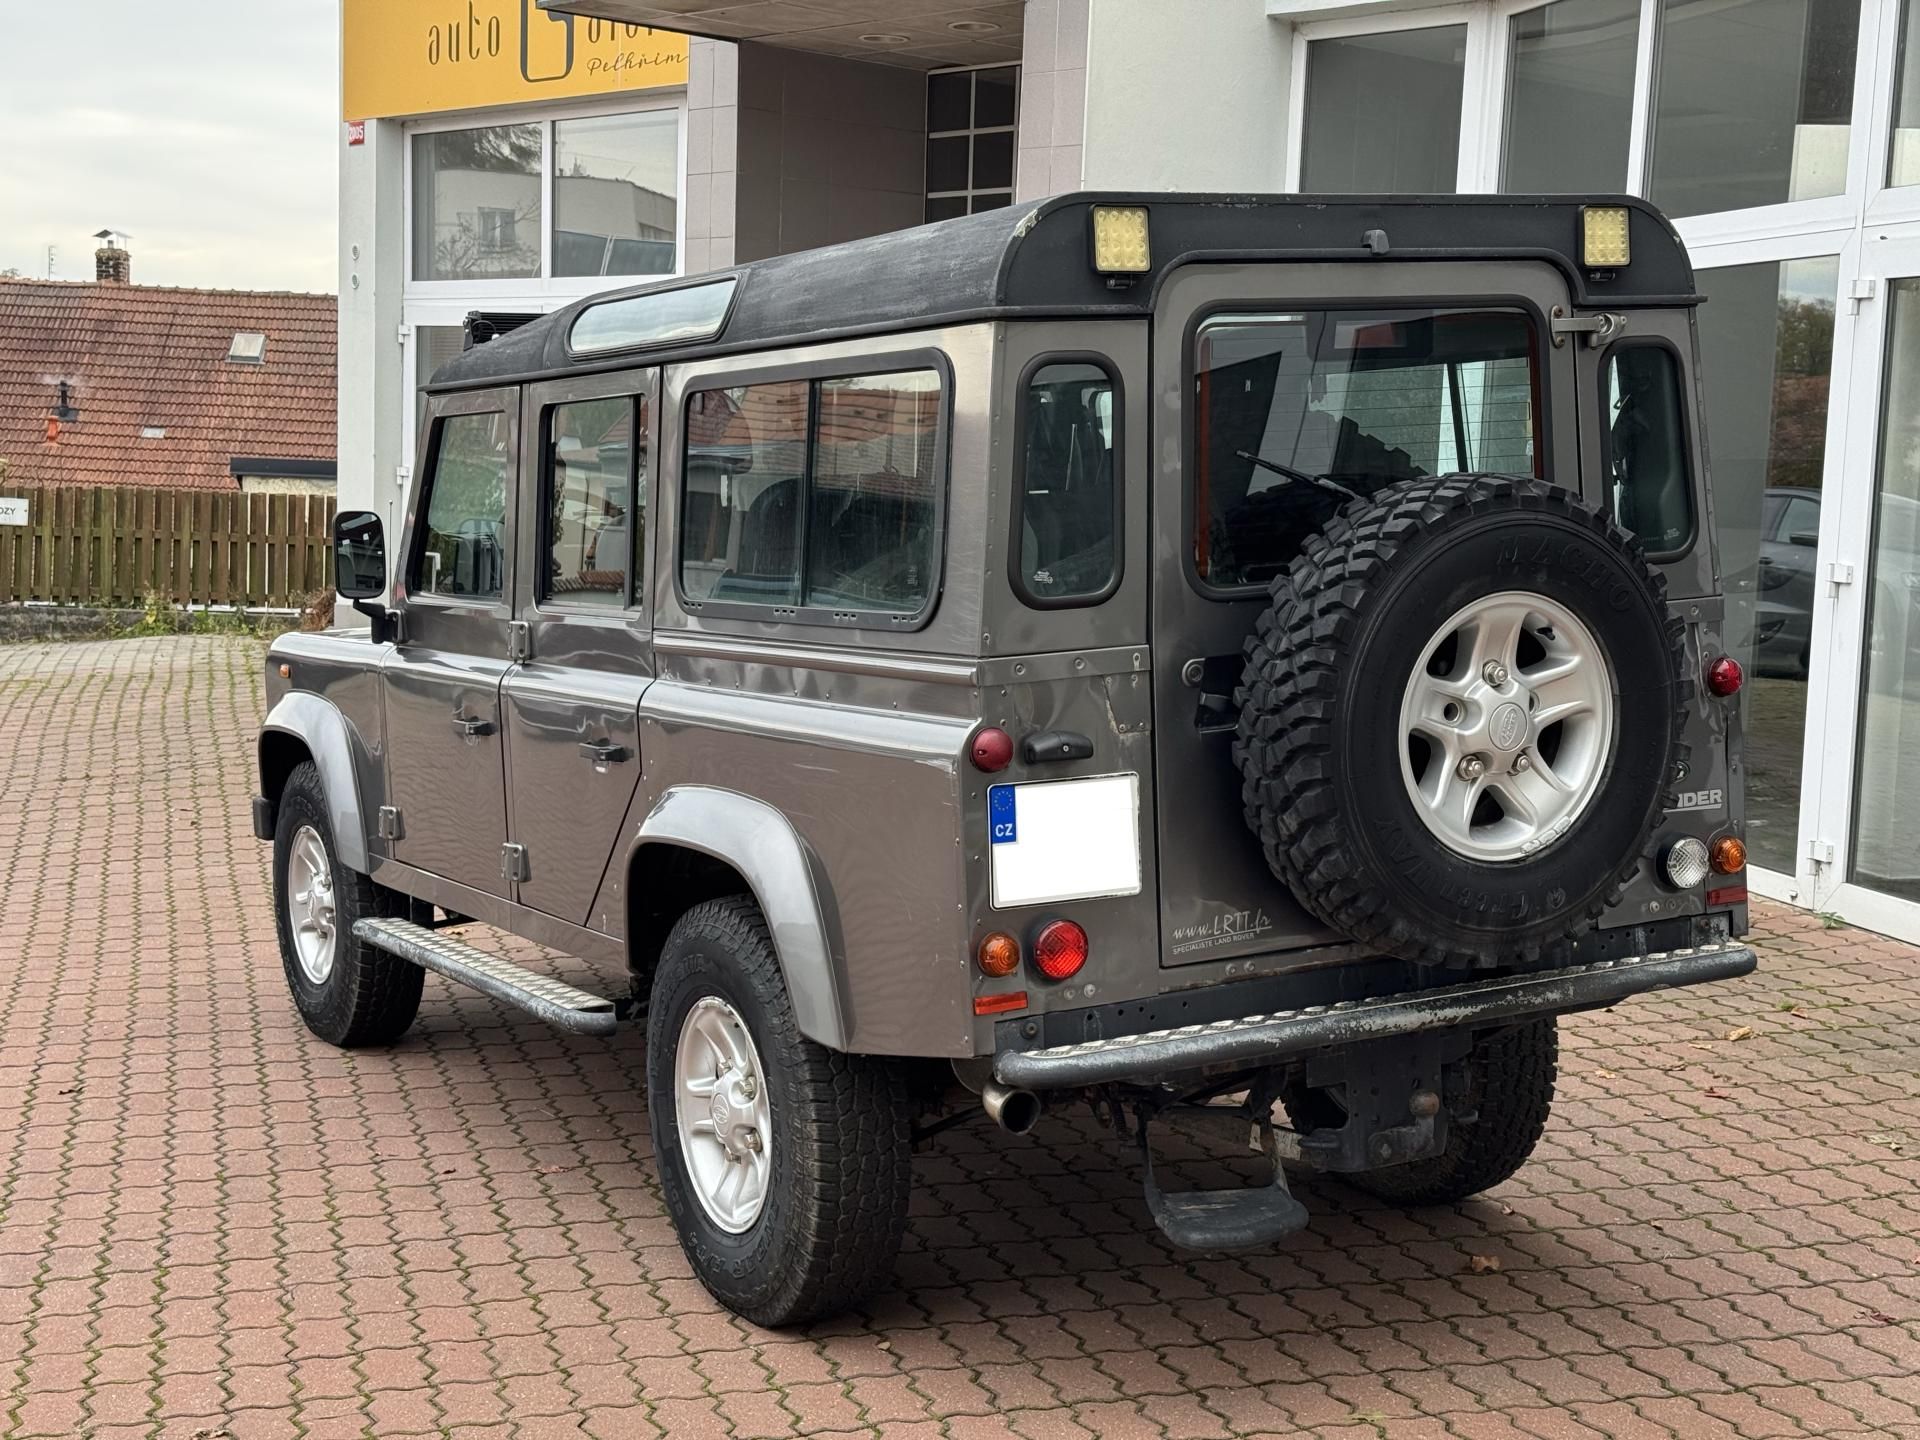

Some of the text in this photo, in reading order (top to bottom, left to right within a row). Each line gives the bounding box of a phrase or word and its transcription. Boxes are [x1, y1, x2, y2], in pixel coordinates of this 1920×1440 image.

[428, 0, 500, 65] auto
[995, 823, 1013, 837] CZ
[1173, 908, 1272, 939] www.LRTT.fr
[1173, 932, 1255, 955] SPECIALISTE LAND ROVER
